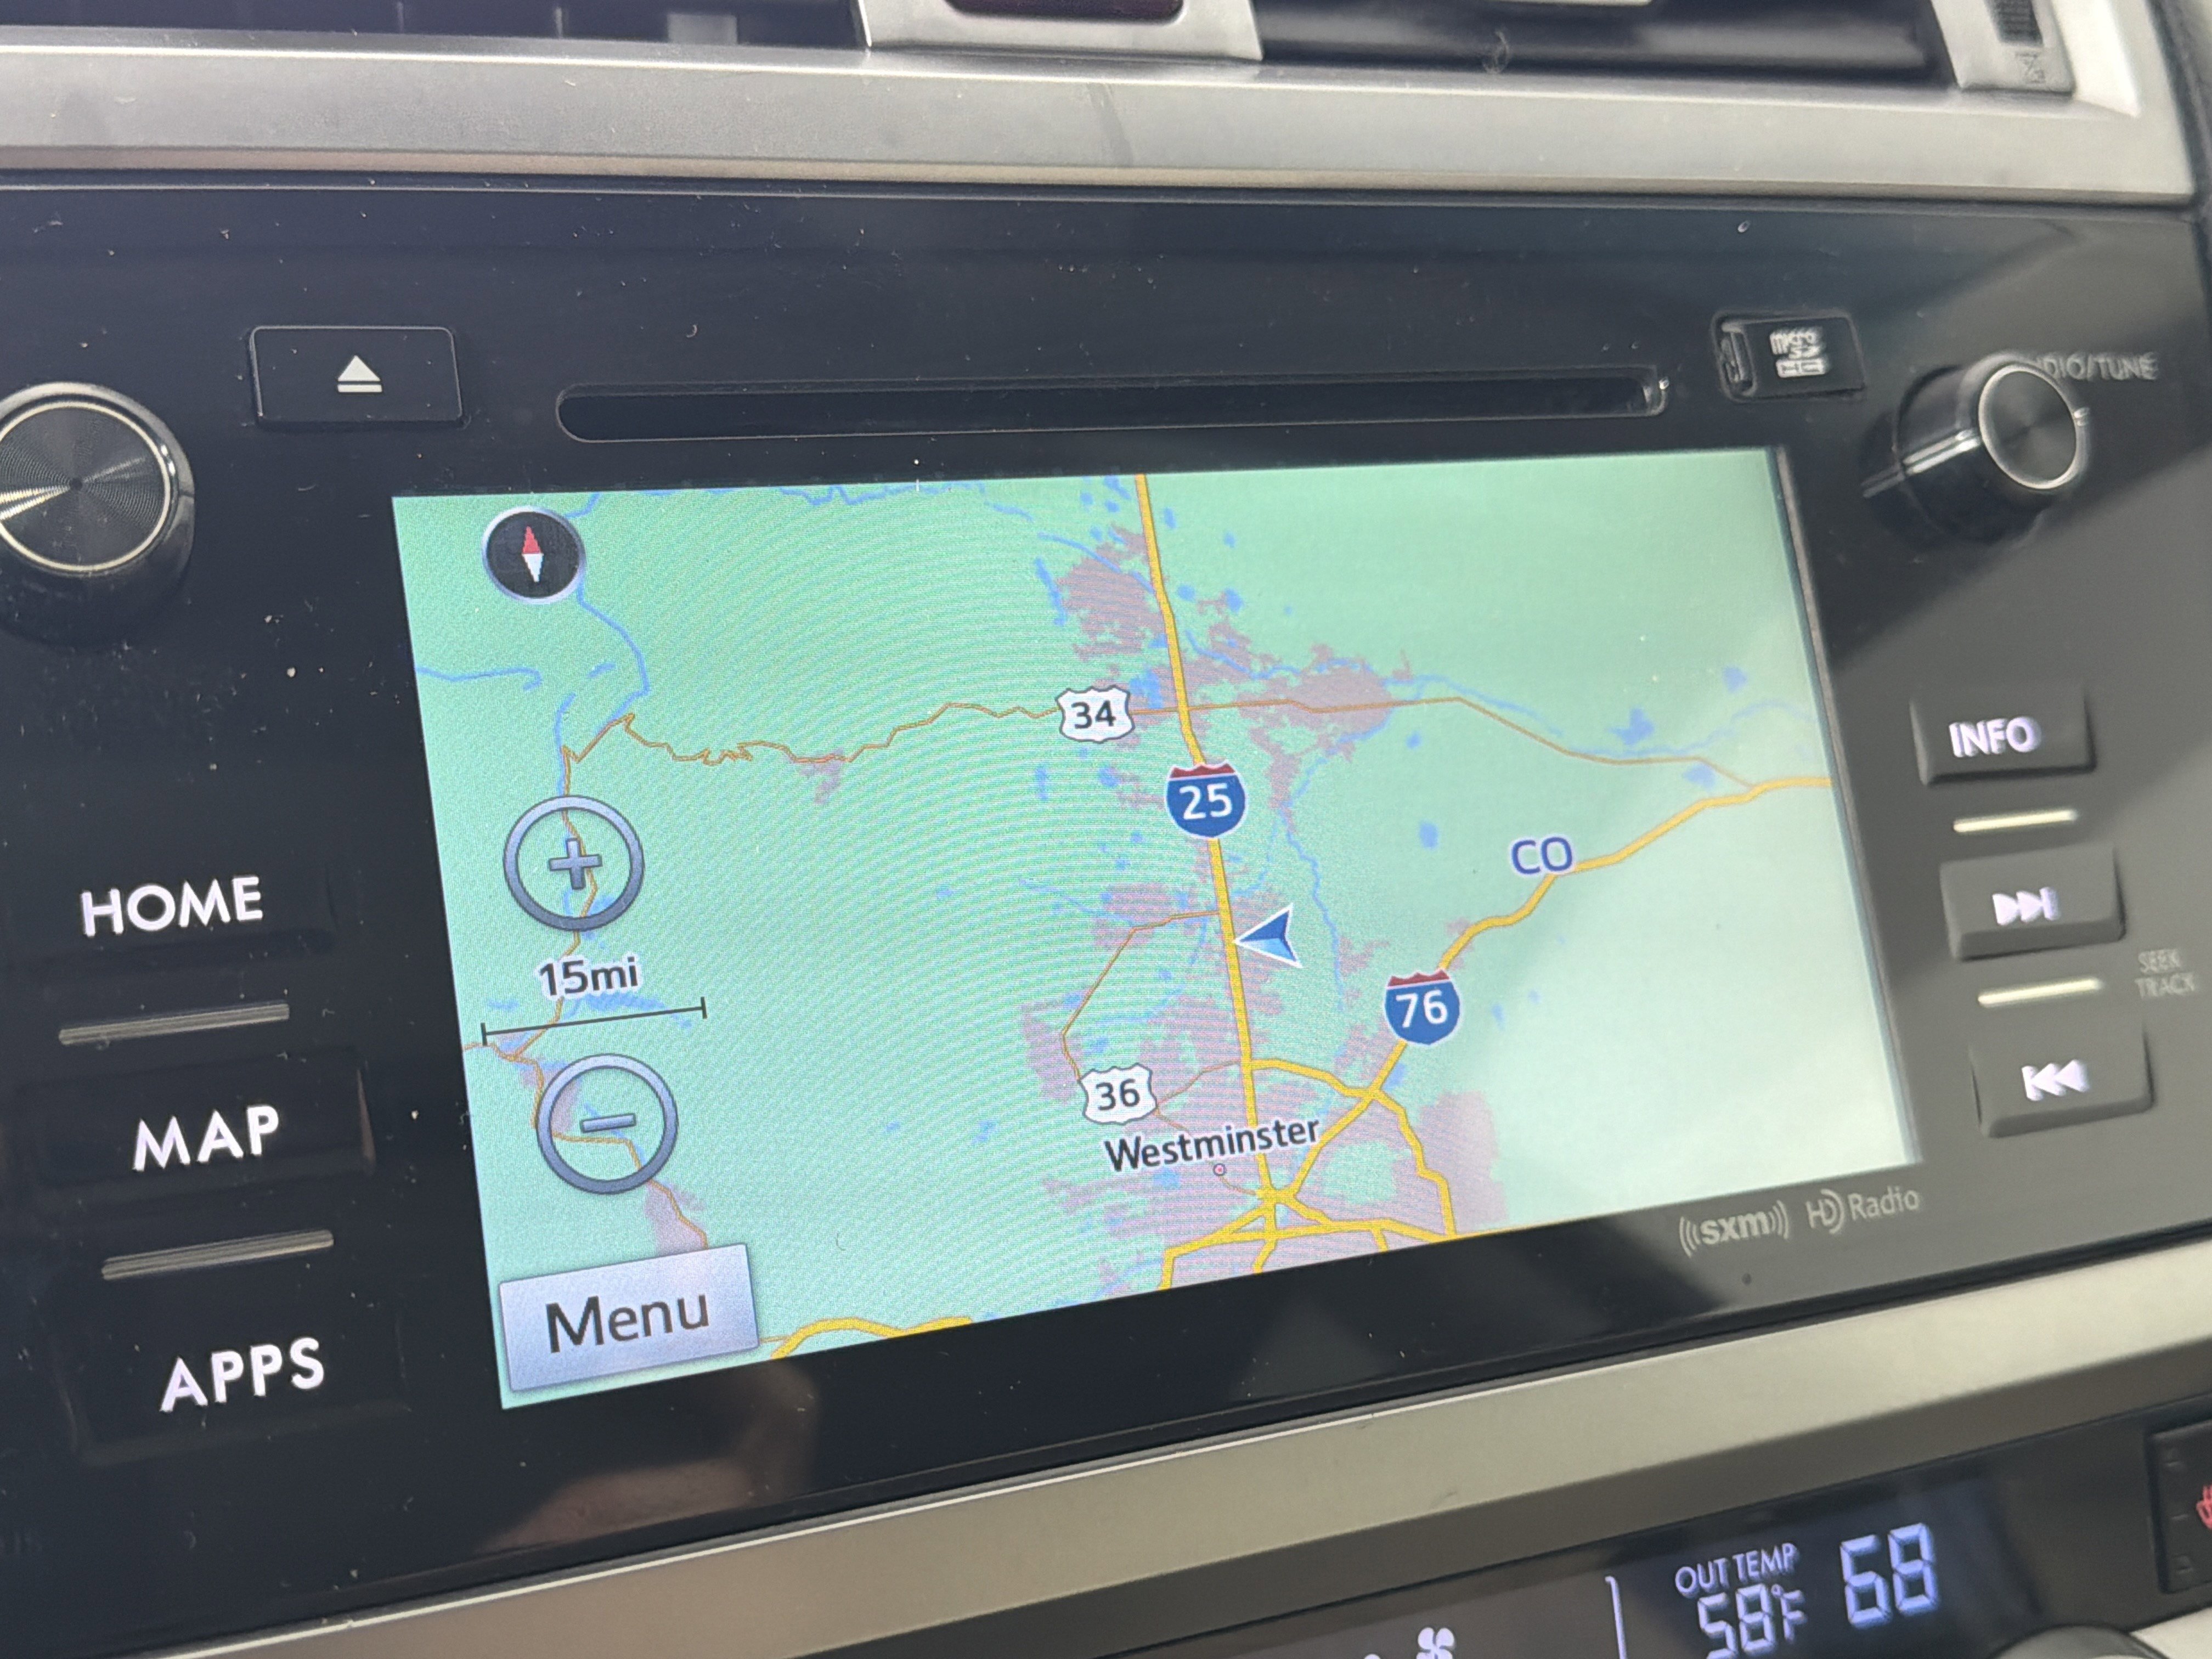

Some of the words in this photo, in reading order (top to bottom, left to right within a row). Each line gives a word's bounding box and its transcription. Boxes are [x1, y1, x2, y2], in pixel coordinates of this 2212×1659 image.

[1071, 700, 1116, 730] 34
[1950, 716, 2041, 758] INFO
[1179, 783, 1233, 820] 25
[1512, 836, 1572, 874] CO
[81, 875, 264, 937] HOME
[539, 957, 639, 996] 15mi
[2138, 949, 2181, 973] SEEK
[2135, 973, 2196, 998] TRACK
[1396, 990, 1448, 1028] 76
[1095, 1077, 1142, 1111] 36
[133, 1105, 279, 1172] MAP
[1105, 1118, 1321, 1171] Westminster
[1848, 1186, 1921, 1221] Radio
[545, 1294, 710, 1353] Menu
[160, 1338, 325, 1413] APPS
[1675, 1558, 1729, 1599] OUT
[1733, 1542, 1801, 1584] TEMP
[1839, 1522, 1940, 1629] 68
